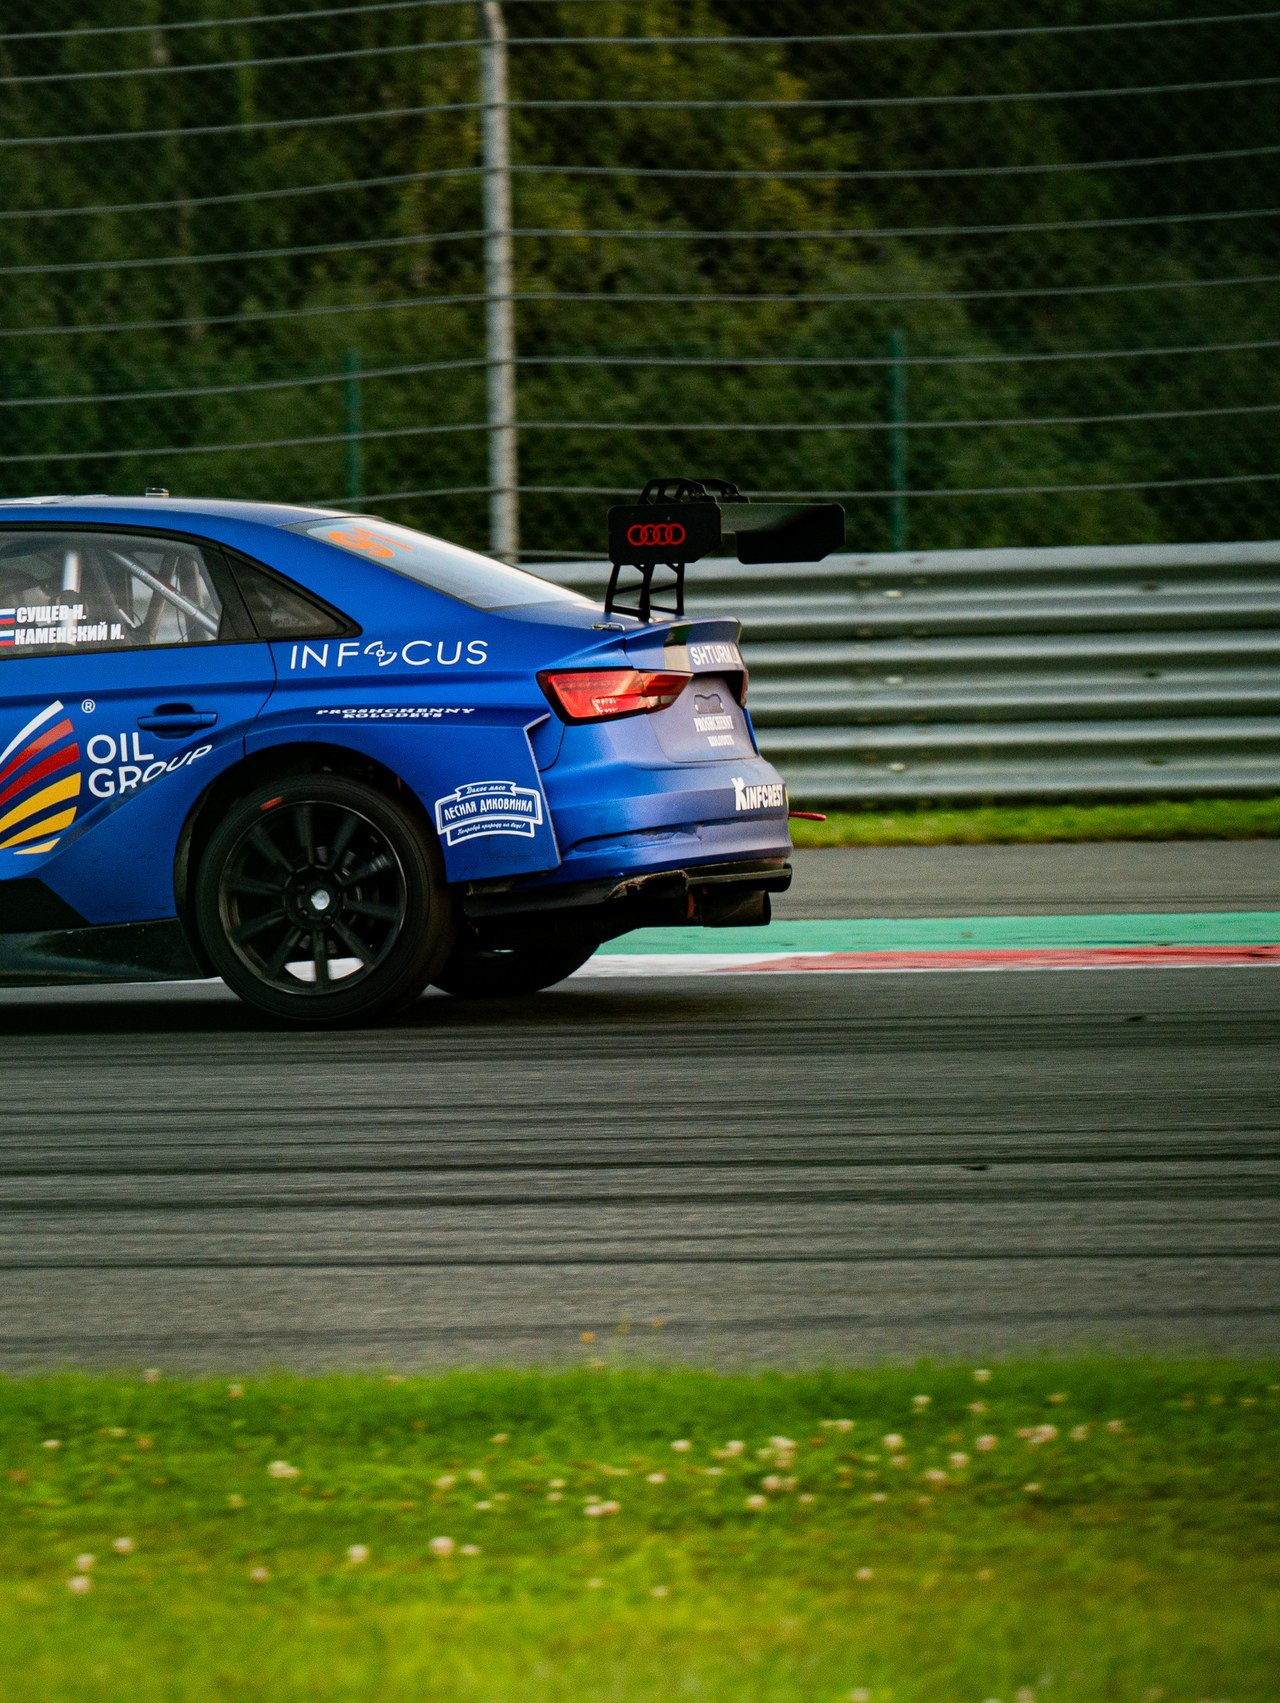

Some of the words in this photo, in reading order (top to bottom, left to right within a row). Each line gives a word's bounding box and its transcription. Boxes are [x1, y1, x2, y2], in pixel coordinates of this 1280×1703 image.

[16, 604, 70, 624] СУЩЕВ
[14, 621, 107, 645] КАМЕНСКИЙ
[86, 731, 155, 764] OIL
[88, 744, 213, 798] GROUP
